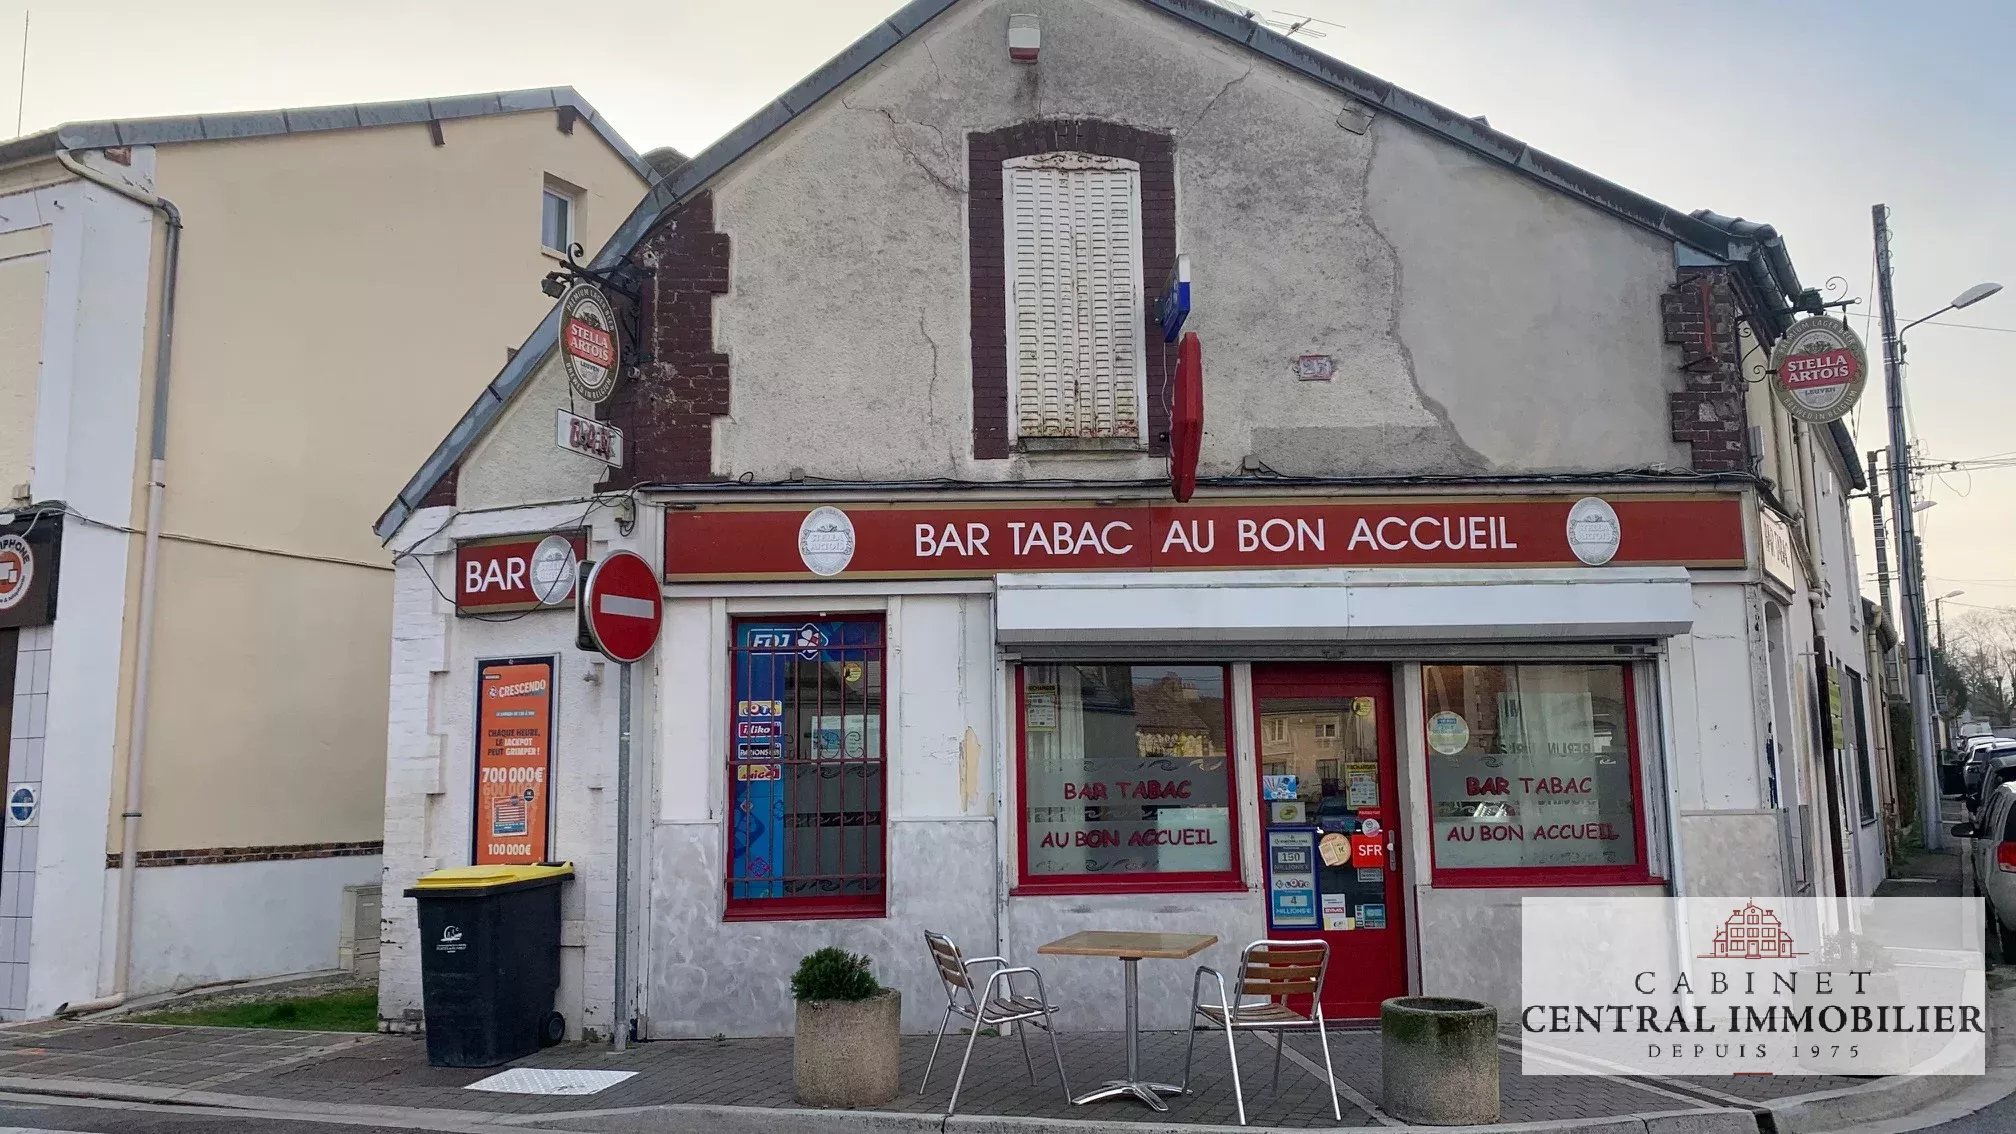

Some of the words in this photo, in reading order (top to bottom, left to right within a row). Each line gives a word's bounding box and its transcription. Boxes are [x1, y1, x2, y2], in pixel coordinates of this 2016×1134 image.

[567, 289, 590, 311] PREMIUM
[1812, 320, 1839, 330] LAGER
[571, 323, 608, 349] STELLA
[570, 337, 609, 362] ARTOIS
[1788, 355, 1848, 372] STELLA
[566, 363, 584, 393] BREWED
[592, 378, 612, 399] BELGIUM
[1788, 366, 1849, 383] ARTOIS
[1805, 386, 1836, 396] LEUVEN
[1783, 396, 1813, 420] BREWED
[1828, 390, 1858, 418] BELGIUM
[916, 523, 990, 556] BAR
[1007, 521, 1133, 555] TABAC
[1161, 520, 1214, 553] AU
[1238, 518, 1324, 553] BON
[1347, 516, 1517, 551] ACCUEIL
[466, 557, 526, 593] BAR
[753, 634, 790, 647] FDJ
[499, 680, 546, 697] CRESCENDO
[505, 738, 533, 747] JACKPOT
[482, 767, 507, 783] 700
[1064, 782, 1108, 801] BAR
[1115, 780, 1192, 800] TABAC
[1466, 777, 1511, 796] BAR
[1519, 776, 1592, 795] TABAC
[1040, 831, 1069, 848] AU
[1075, 829, 1119, 848] BON
[1128, 828, 1217, 846] ACCUEIL
[1447, 825, 1475, 842] AU
[1480, 825, 1524, 842] BON
[1533, 822, 1620, 841] ACCUEIL
[488, 844, 505, 855] 100
[507, 844, 531, 856] 000€
[1358, 844, 1383, 856] SFR
